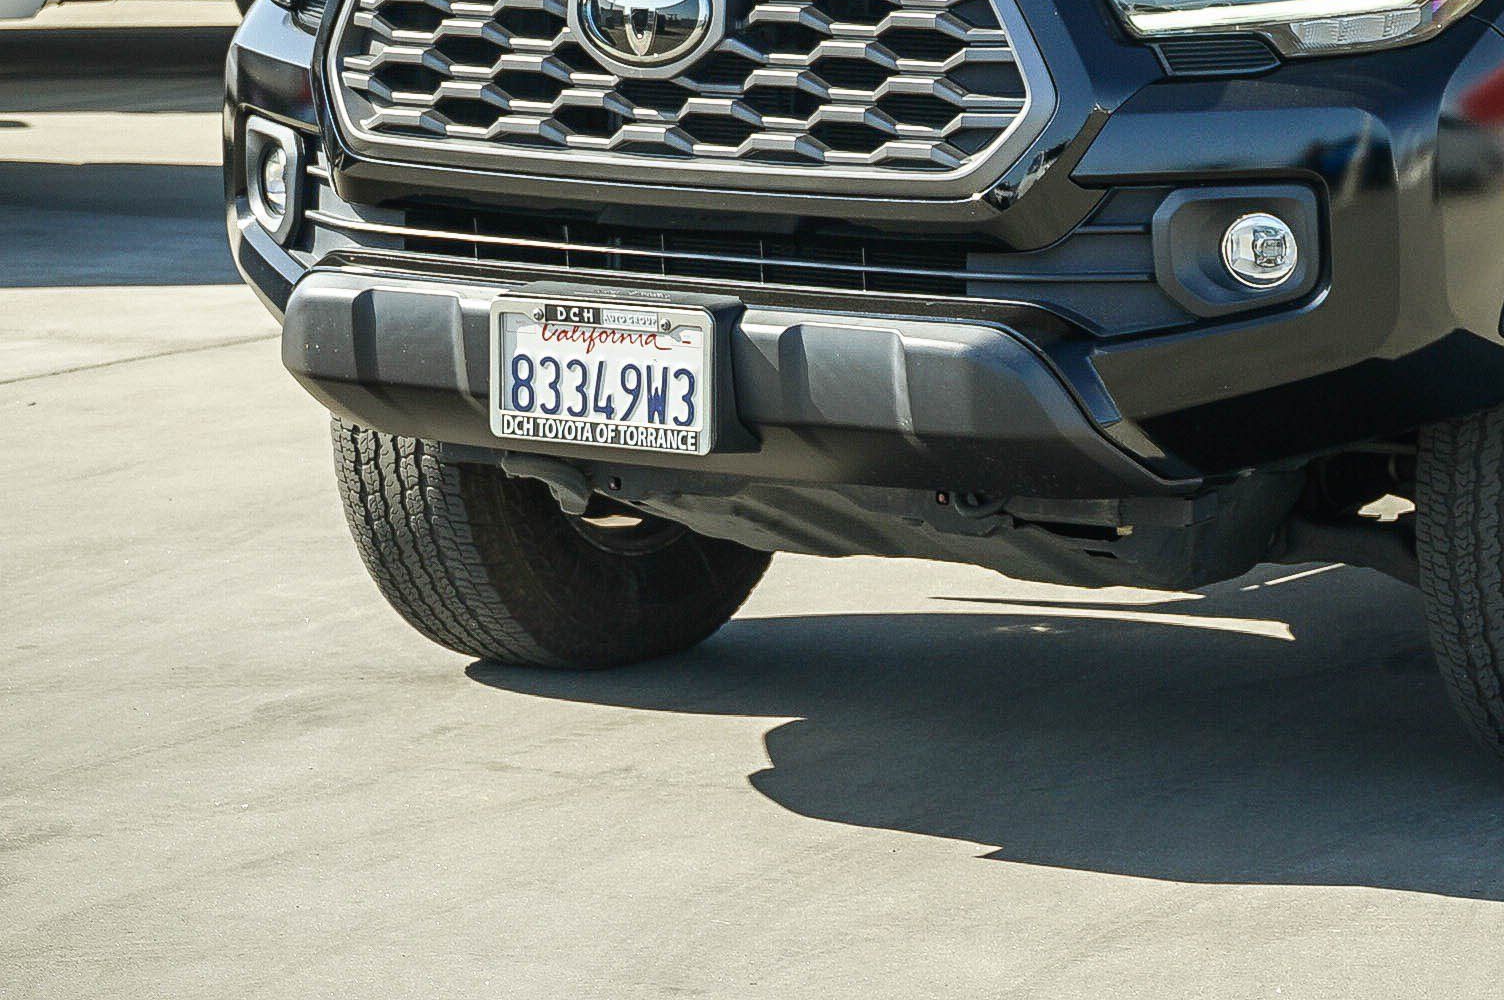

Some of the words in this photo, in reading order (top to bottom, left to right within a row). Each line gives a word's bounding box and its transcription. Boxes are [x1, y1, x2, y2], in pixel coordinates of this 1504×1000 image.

[556, 306, 595, 324] DCH
[541, 322, 672, 354] California
[511, 353, 696, 426] 83349W3
[503, 414, 534, 437] DCH
[536, 418, 593, 442] TOYOTA
[596, 424, 616, 443] OF
[619, 426, 698, 451] TORRANCE
